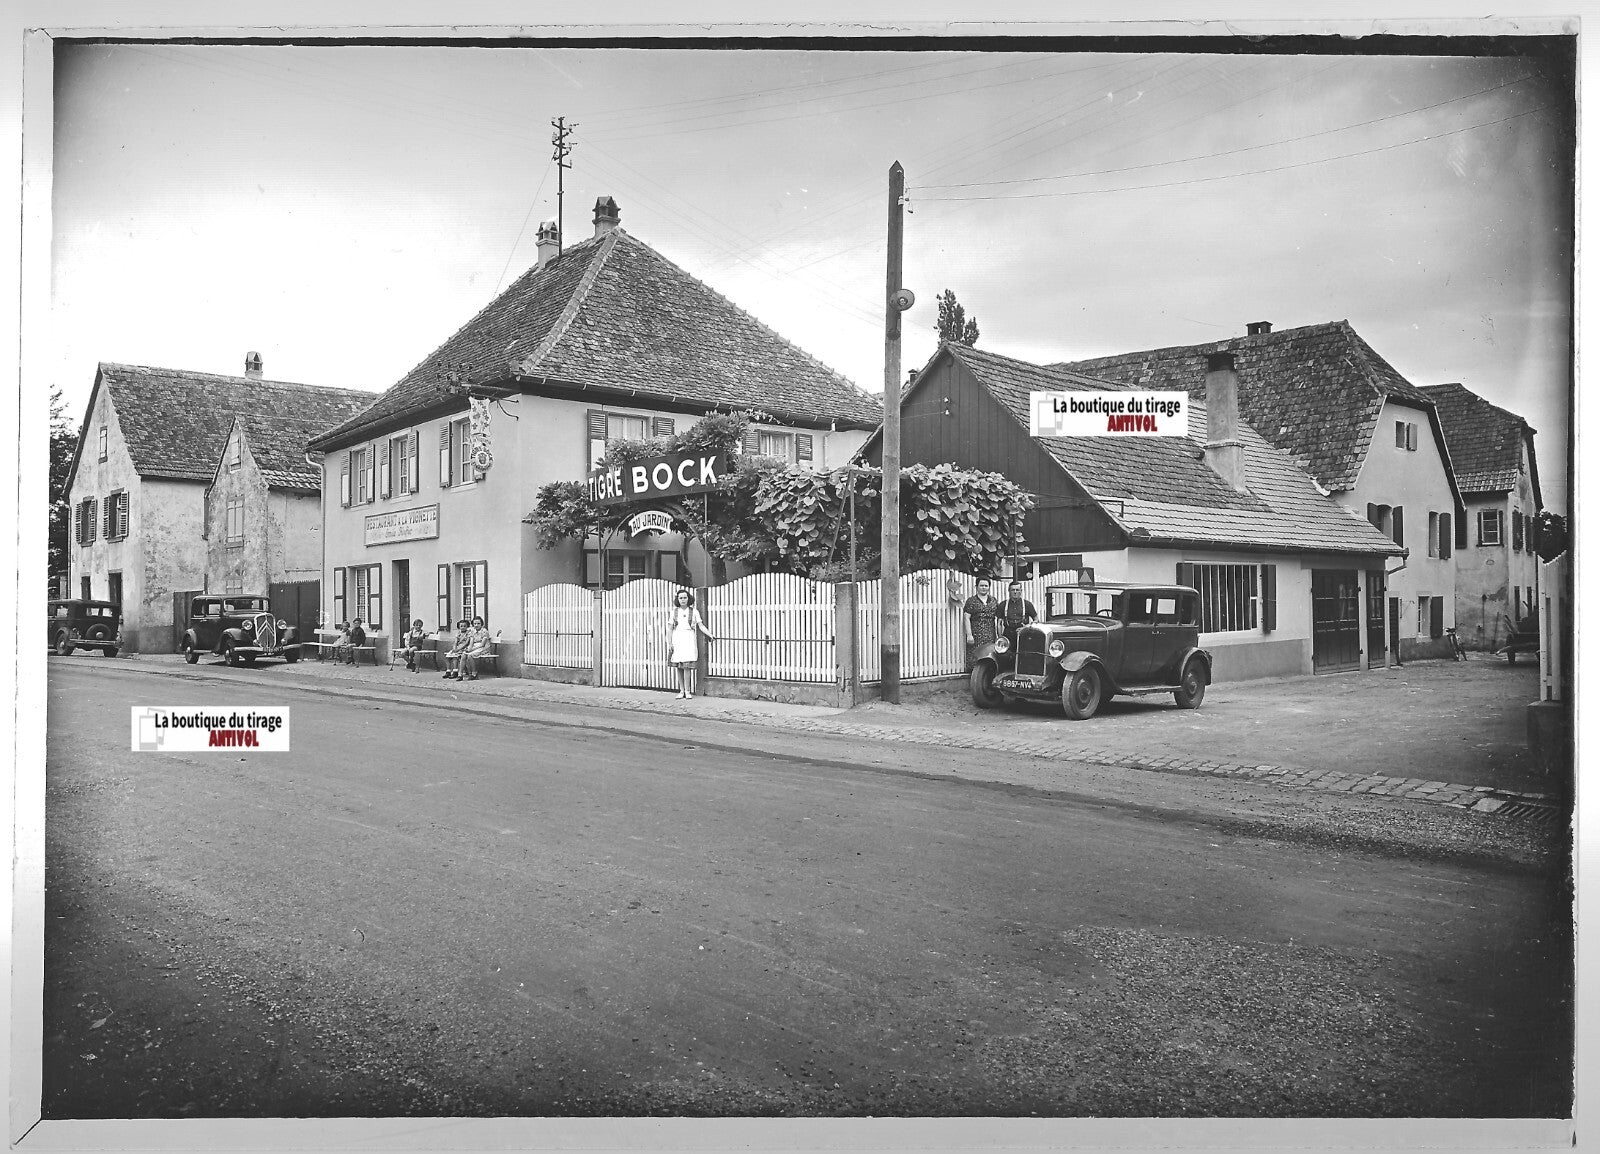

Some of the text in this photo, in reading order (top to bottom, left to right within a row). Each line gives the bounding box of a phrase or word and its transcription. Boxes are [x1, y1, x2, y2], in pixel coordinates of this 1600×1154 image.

[589, 456, 718, 502] TIGRE BOCK
[632, 513, 669, 533] AU JARDIN
